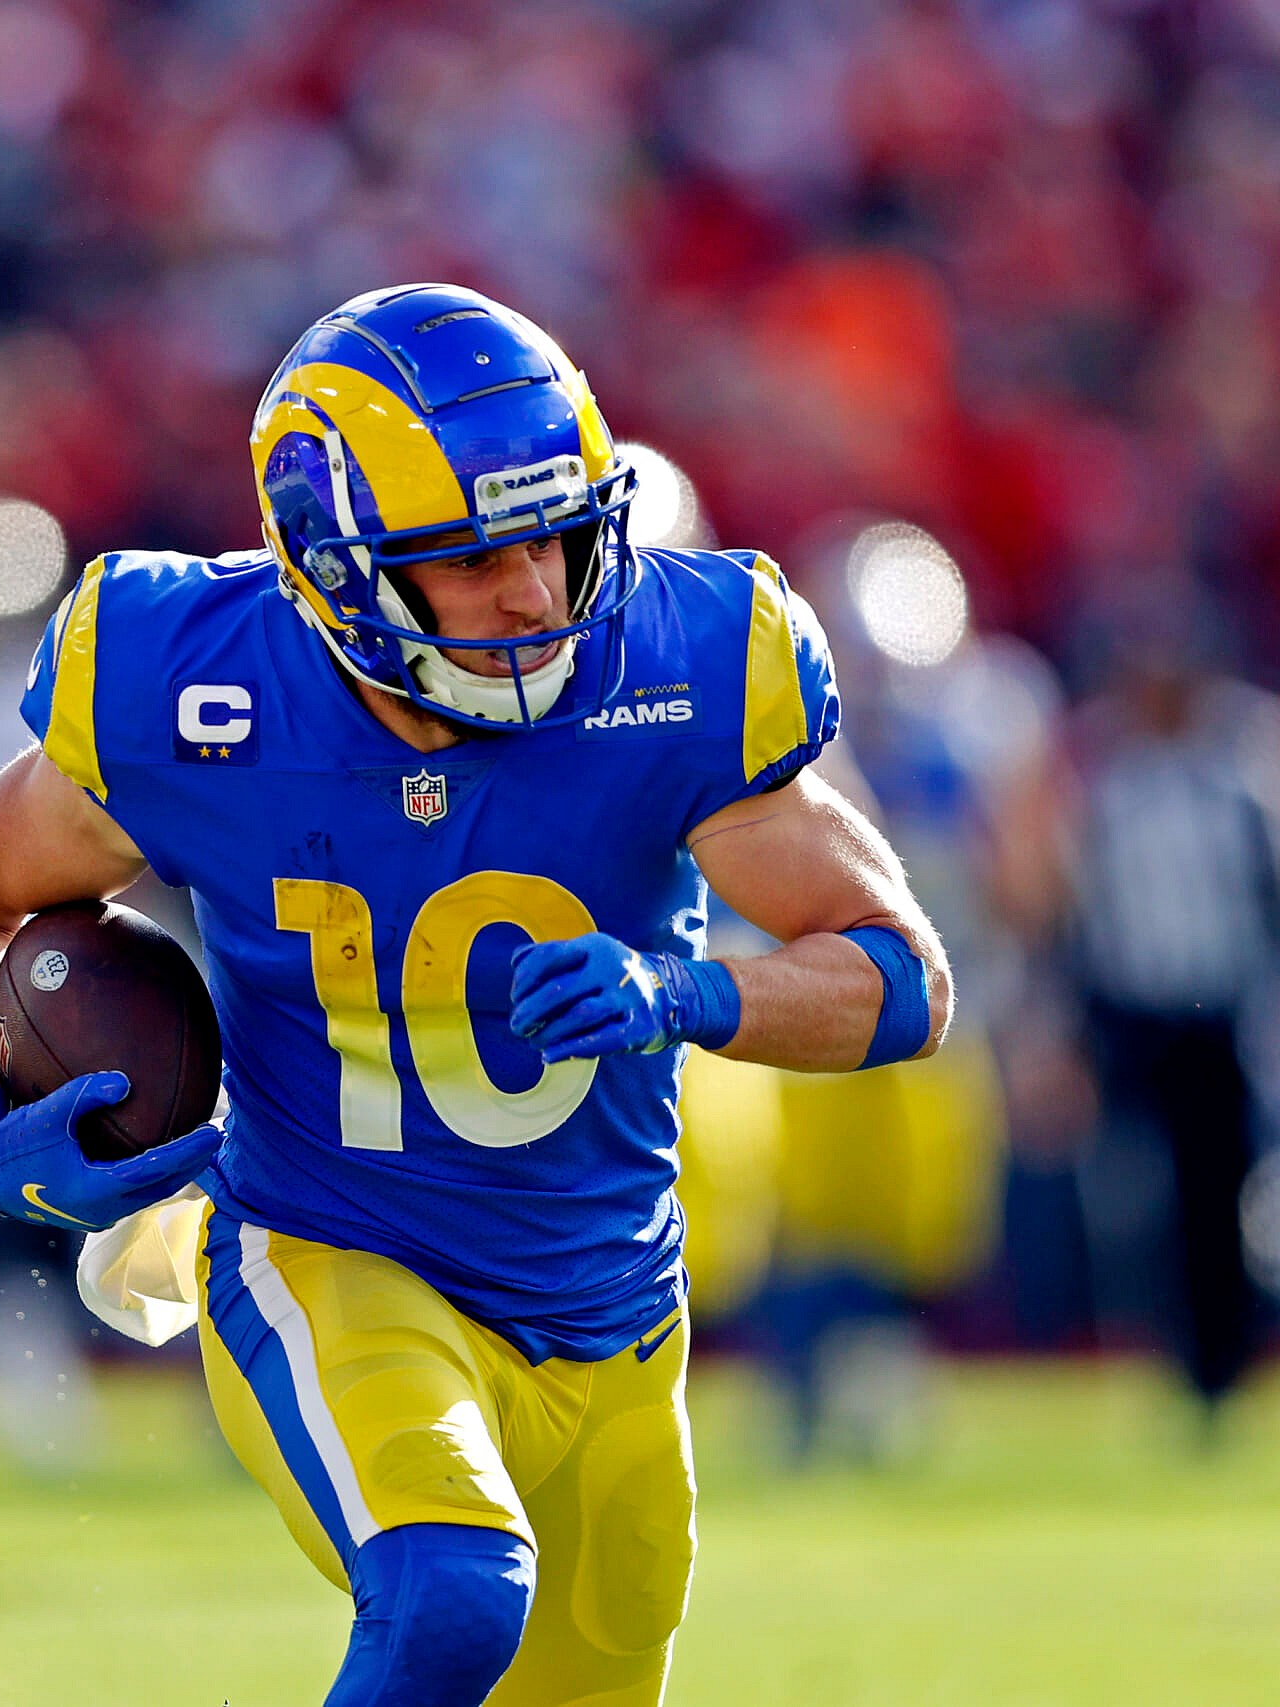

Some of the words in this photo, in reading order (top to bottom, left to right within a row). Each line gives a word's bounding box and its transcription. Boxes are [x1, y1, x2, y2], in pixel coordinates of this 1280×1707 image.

[503, 469, 556, 490] RAMS
[178, 684, 252, 743] C
[584, 699, 693, 729] RAMS
[411, 795, 440, 816] NFL
[46, 954, 67, 977] 233
[273, 869, 599, 1151] 10
